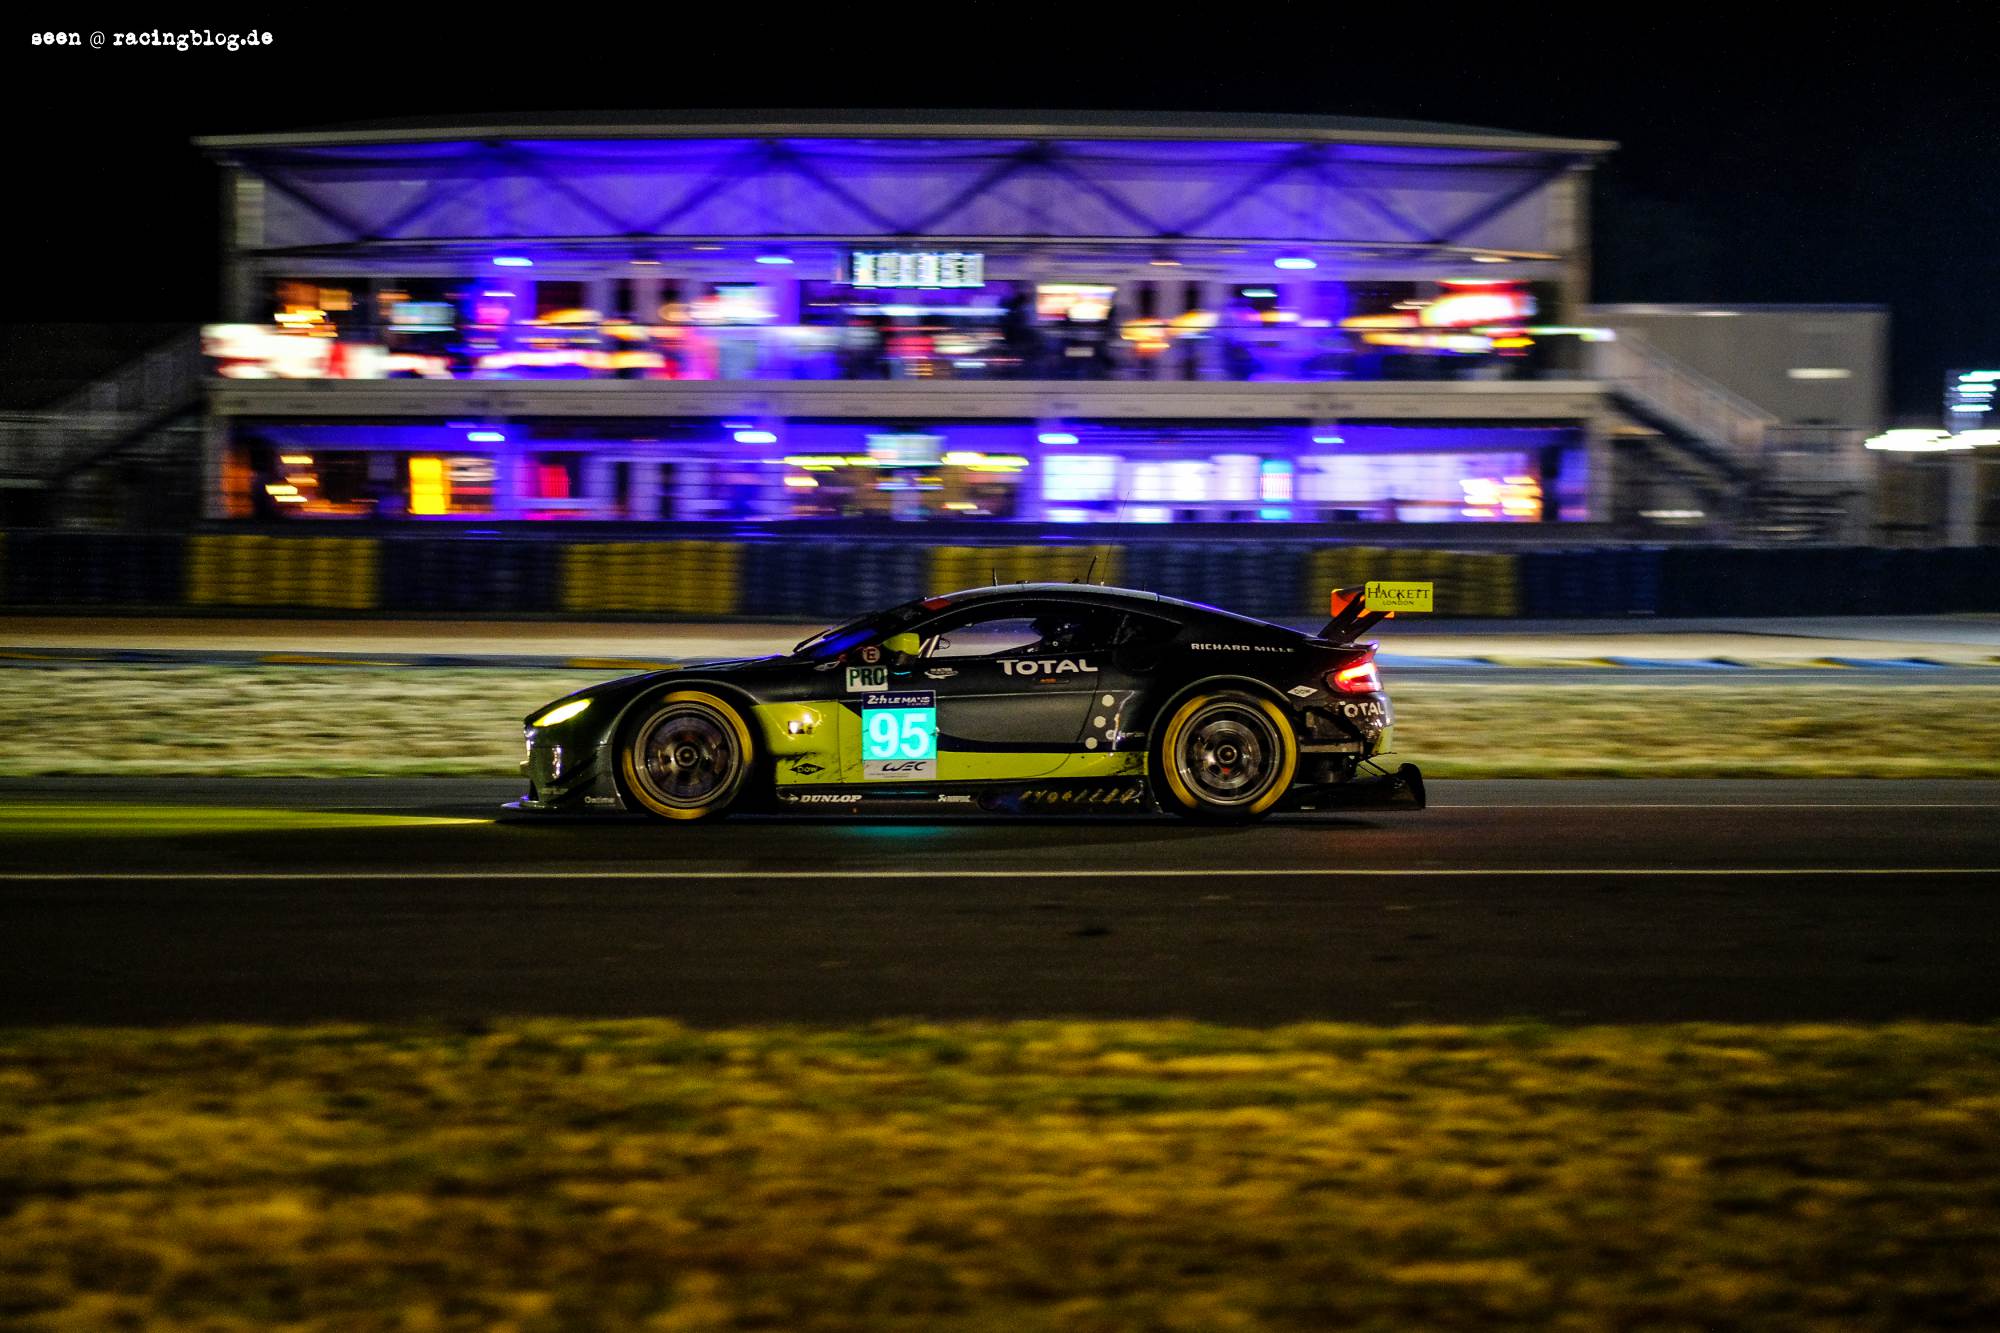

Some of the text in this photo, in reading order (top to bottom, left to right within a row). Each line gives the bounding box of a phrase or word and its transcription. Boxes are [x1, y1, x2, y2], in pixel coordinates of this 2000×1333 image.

[1367, 587, 1431, 599] HACKETT
[1190, 643, 1296, 653] RICHARD MILLE
[996, 659, 1099, 676] TOTAL
[849, 667, 886, 687] PRO
[1339, 701, 1385, 718] OTAL
[869, 712, 930, 758] 95
[881, 761, 928, 772] WEC
[799, 794, 863, 803] DUNLOP
